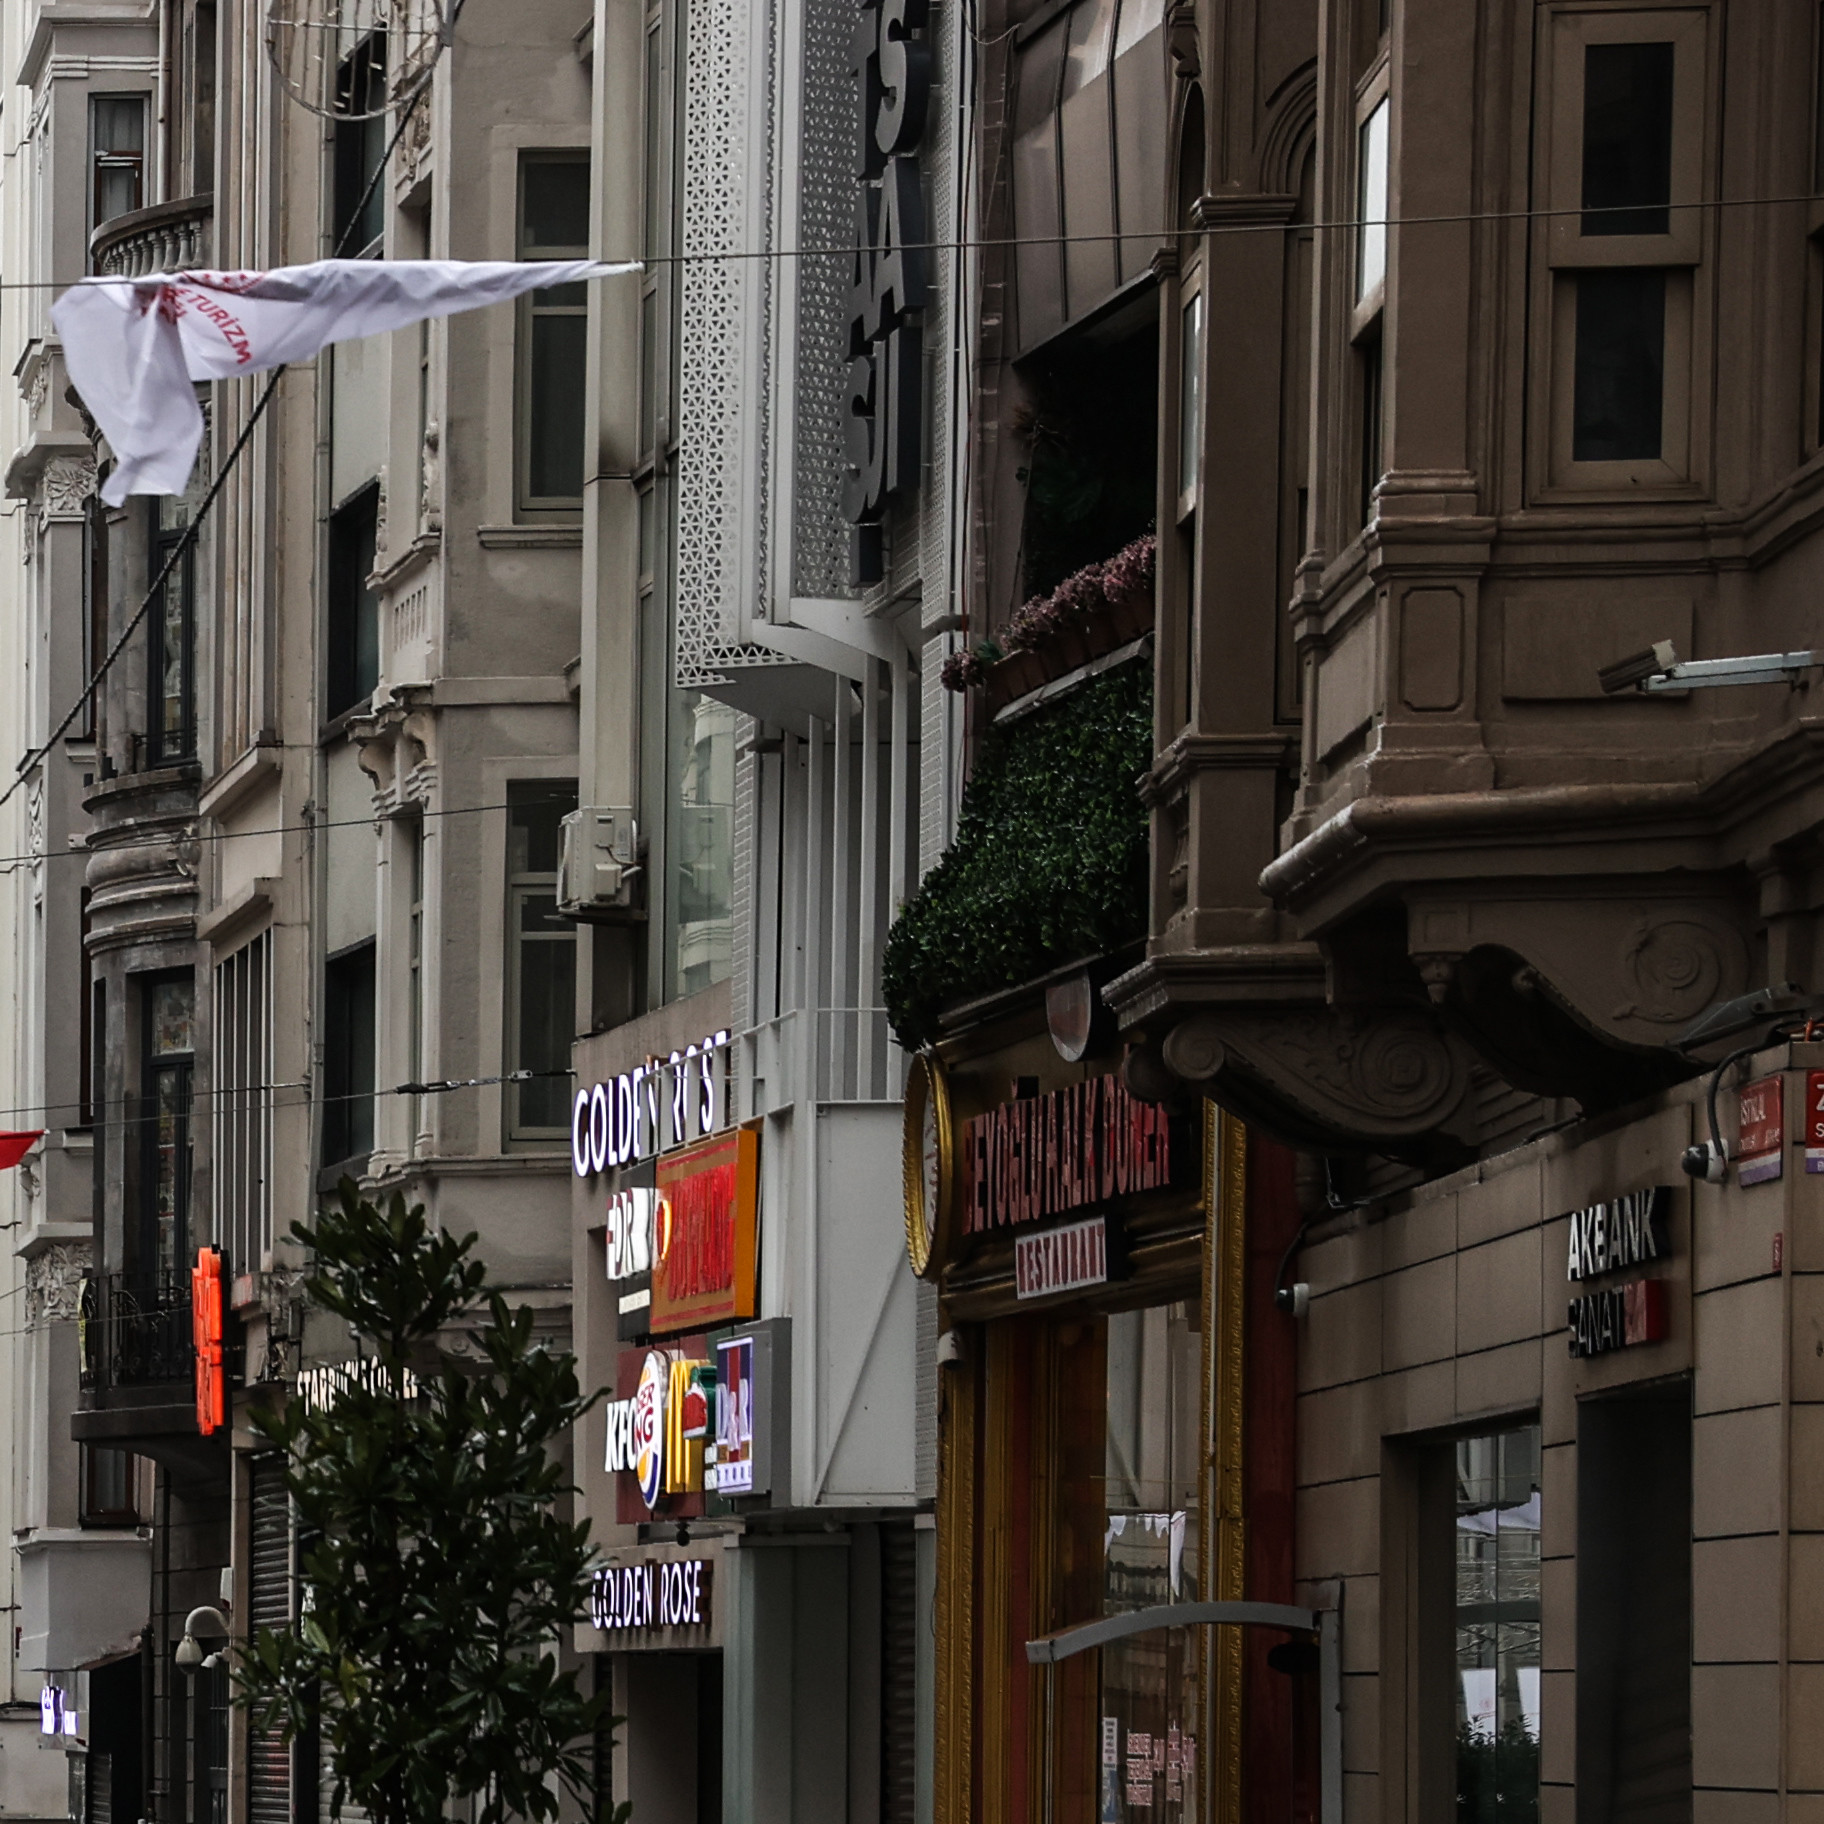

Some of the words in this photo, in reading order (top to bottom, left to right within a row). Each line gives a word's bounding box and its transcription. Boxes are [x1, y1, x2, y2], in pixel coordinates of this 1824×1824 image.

[188, 295, 251, 365] TURİZM
[1017, 1223, 1106, 1294] RESTAURANT
[1568, 1186, 1657, 1282] AKBANK
[1568, 1286, 1624, 1358] SANAT
[591, 1564, 654, 1630] GOLDEN
[660, 1560, 702, 1625] ROSE
